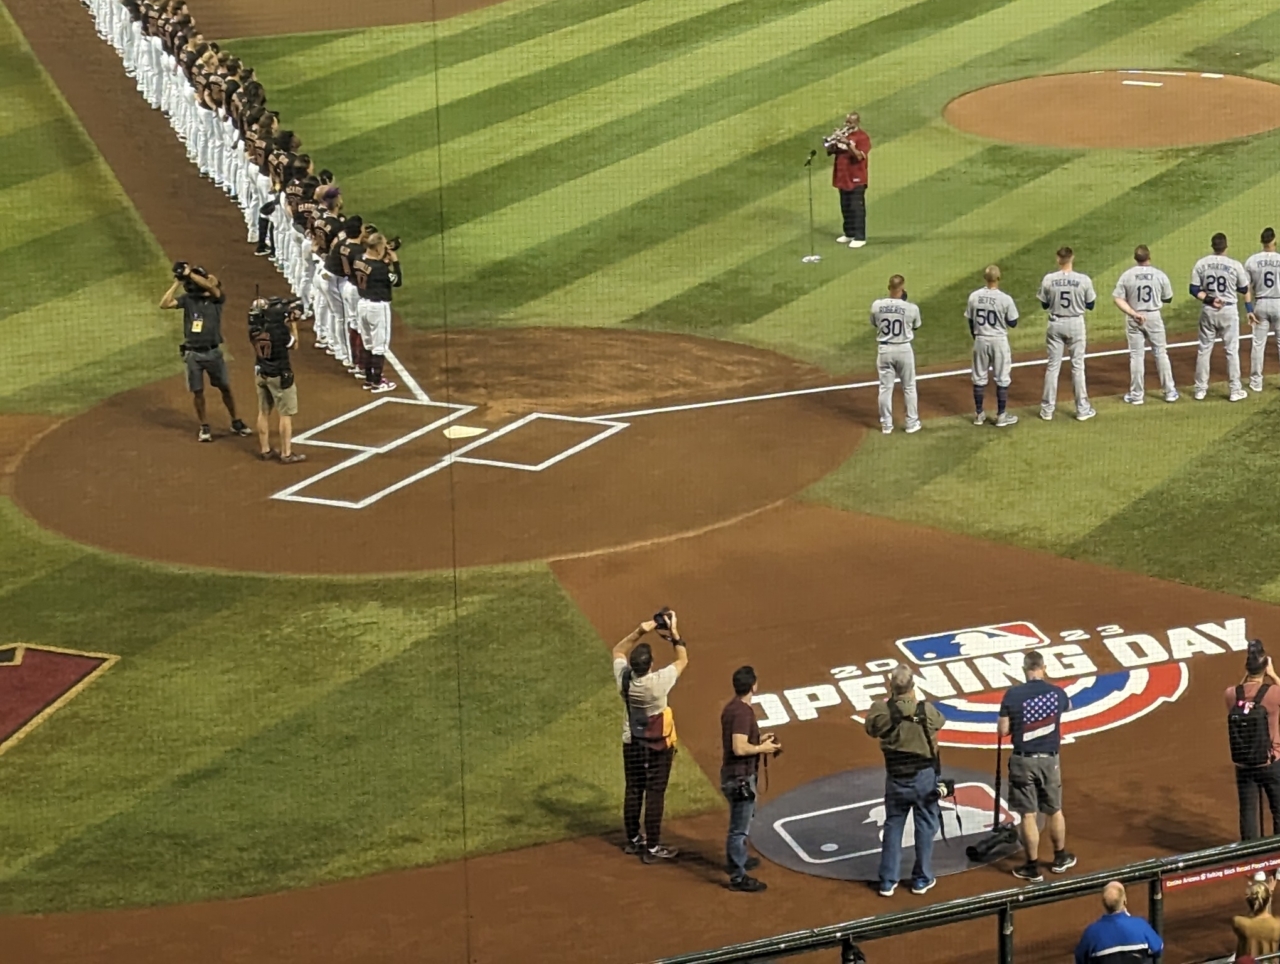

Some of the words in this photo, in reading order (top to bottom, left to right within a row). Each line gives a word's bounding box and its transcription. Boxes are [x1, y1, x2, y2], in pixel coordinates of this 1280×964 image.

[1051, 279, 1081, 288] FREEMAN
[1206, 275, 1227, 293] 28
[1264, 271, 1275, 288] 6
[978, 296, 996, 305] BETTS
[1060, 291, 1071, 309] 5
[1137, 285, 1152, 303] 13
[879, 306, 906, 315] ROBERTS
[976, 309, 997, 326] 50
[881, 318, 902, 337] 30
[830, 659, 899, 679] 20
[1059, 624, 1125, 642] 23
[1103, 618, 1248, 668] DAY
